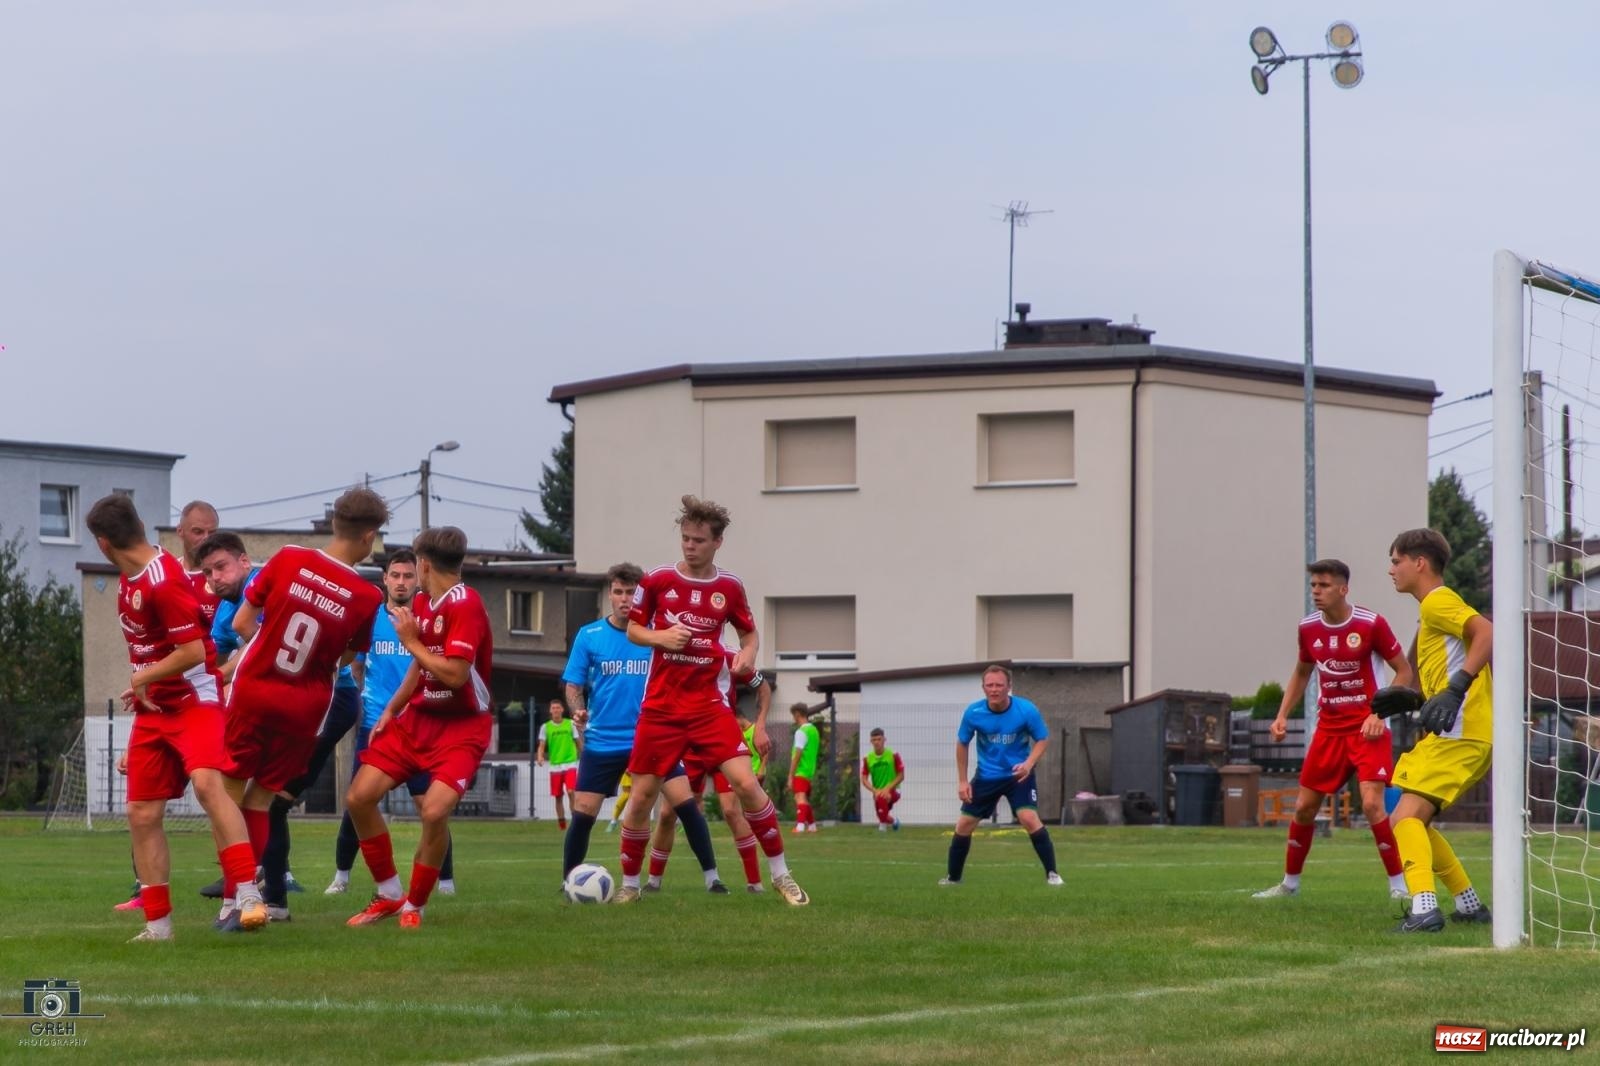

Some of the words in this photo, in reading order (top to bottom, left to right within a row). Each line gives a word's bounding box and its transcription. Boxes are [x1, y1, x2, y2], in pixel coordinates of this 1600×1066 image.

[289, 582, 314, 603] UNIA
[313, 594, 346, 619] TURZA
[276, 611, 319, 673] 9
[601, 659, 648, 675] DAR-BUD
[1031, 789, 1037, 801] 5
